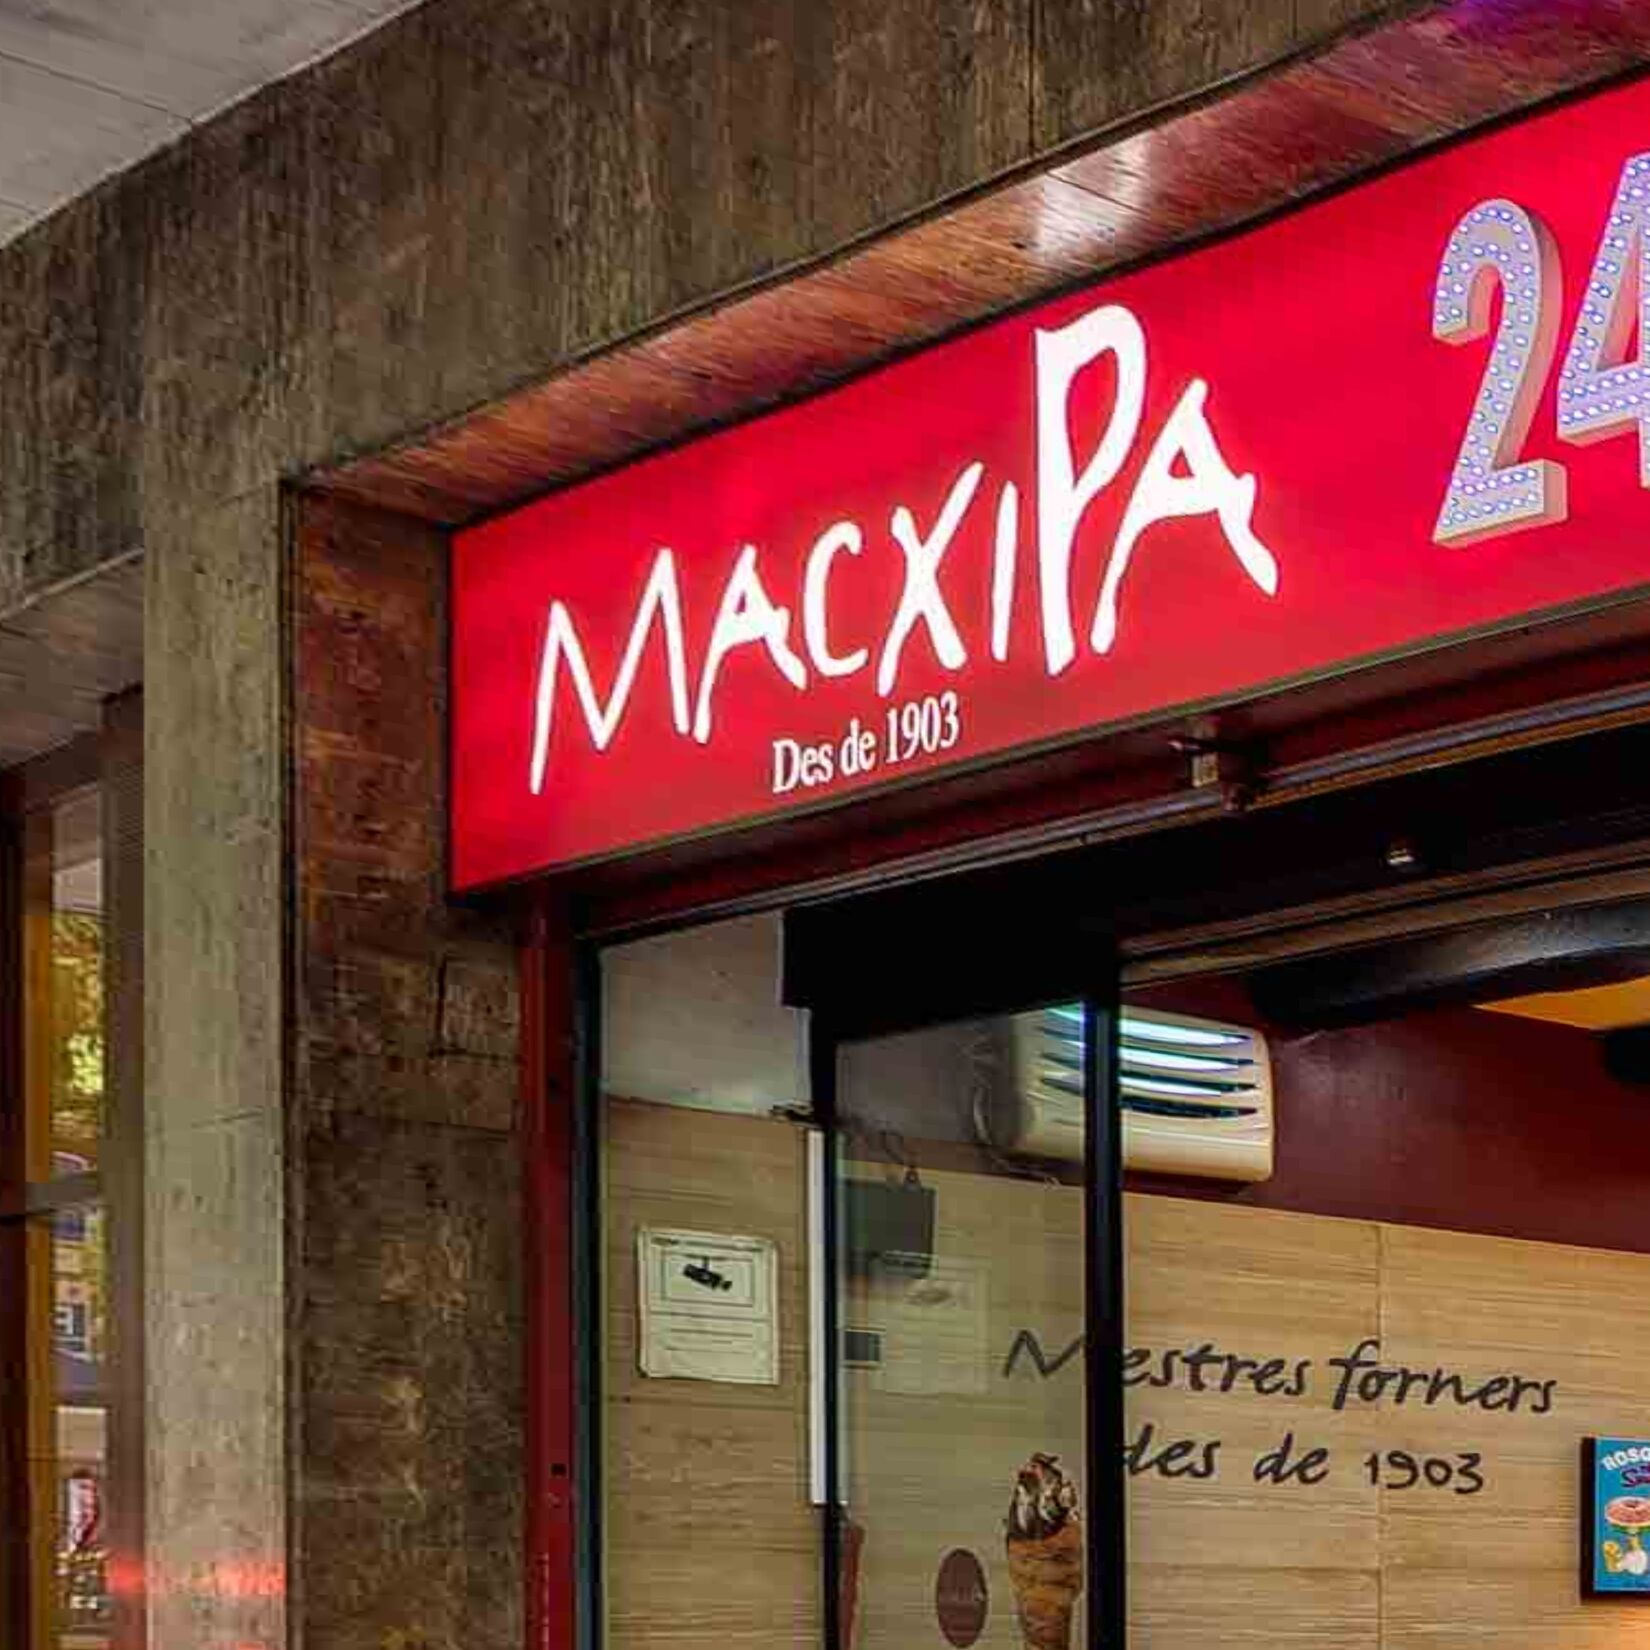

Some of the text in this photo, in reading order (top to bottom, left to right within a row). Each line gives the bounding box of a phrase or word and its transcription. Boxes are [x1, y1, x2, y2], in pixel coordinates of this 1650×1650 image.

[772, 690, 960, 795] Des de 1903
[1328, 1340, 1557, 1413] forners
[1254, 1431, 1328, 1486] de
[1365, 1451, 1485, 1494] 1903
